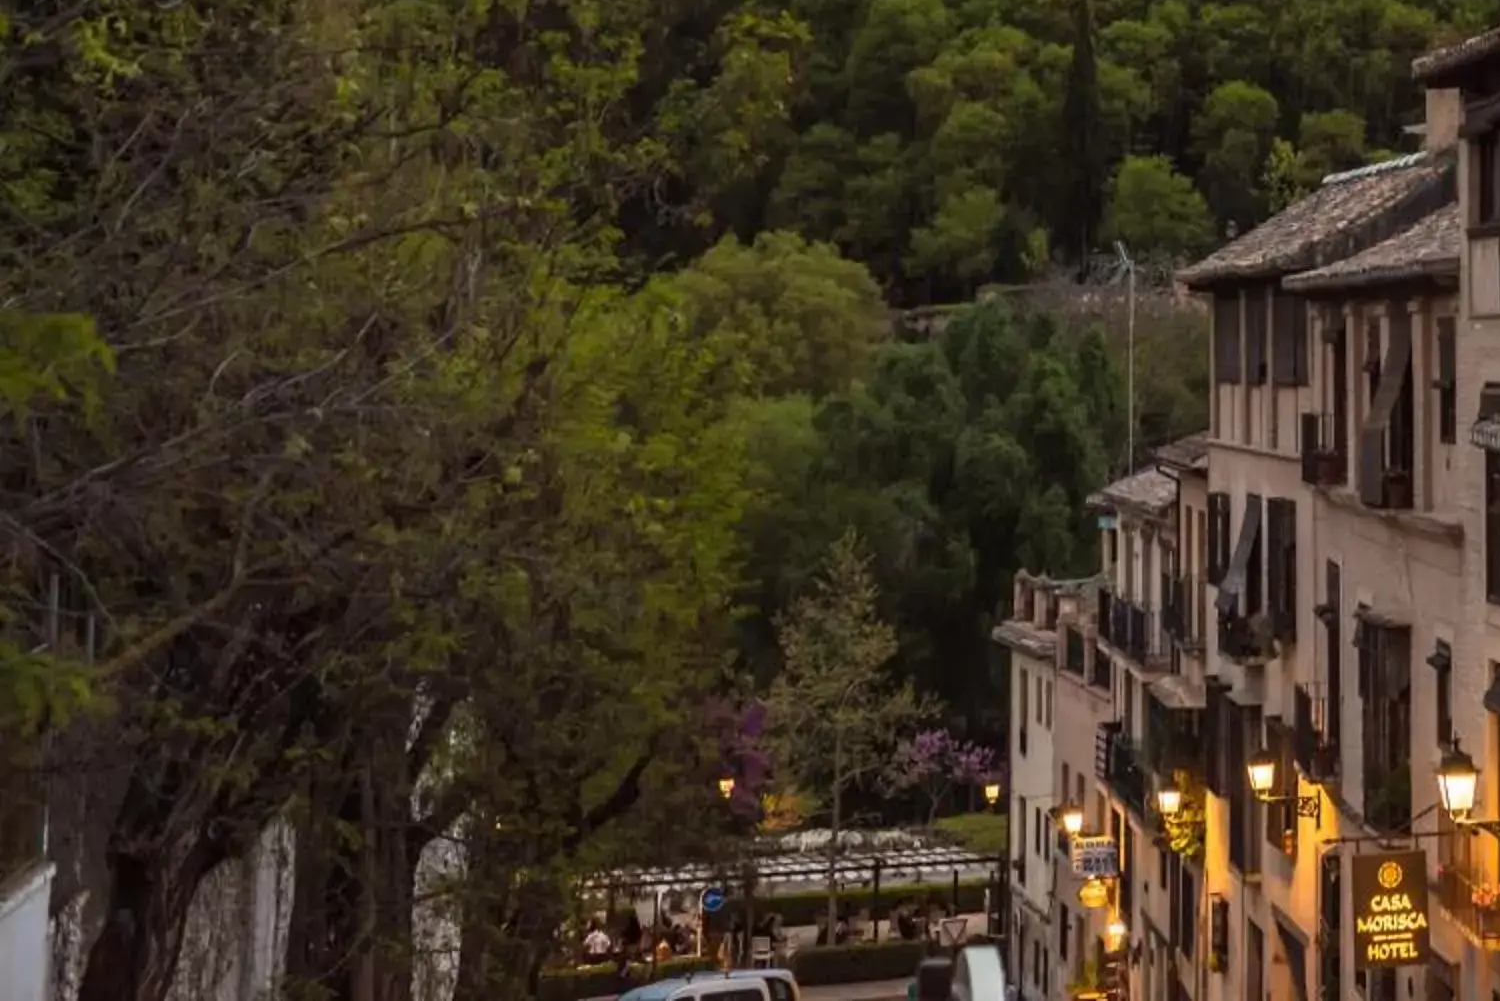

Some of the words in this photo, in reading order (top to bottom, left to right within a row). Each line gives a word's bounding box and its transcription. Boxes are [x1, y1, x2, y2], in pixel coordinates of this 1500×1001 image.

[1371, 893, 1412, 912] CASA
[1357, 911, 1428, 933] MORISCA
[1367, 942, 1418, 961] HOTEL
